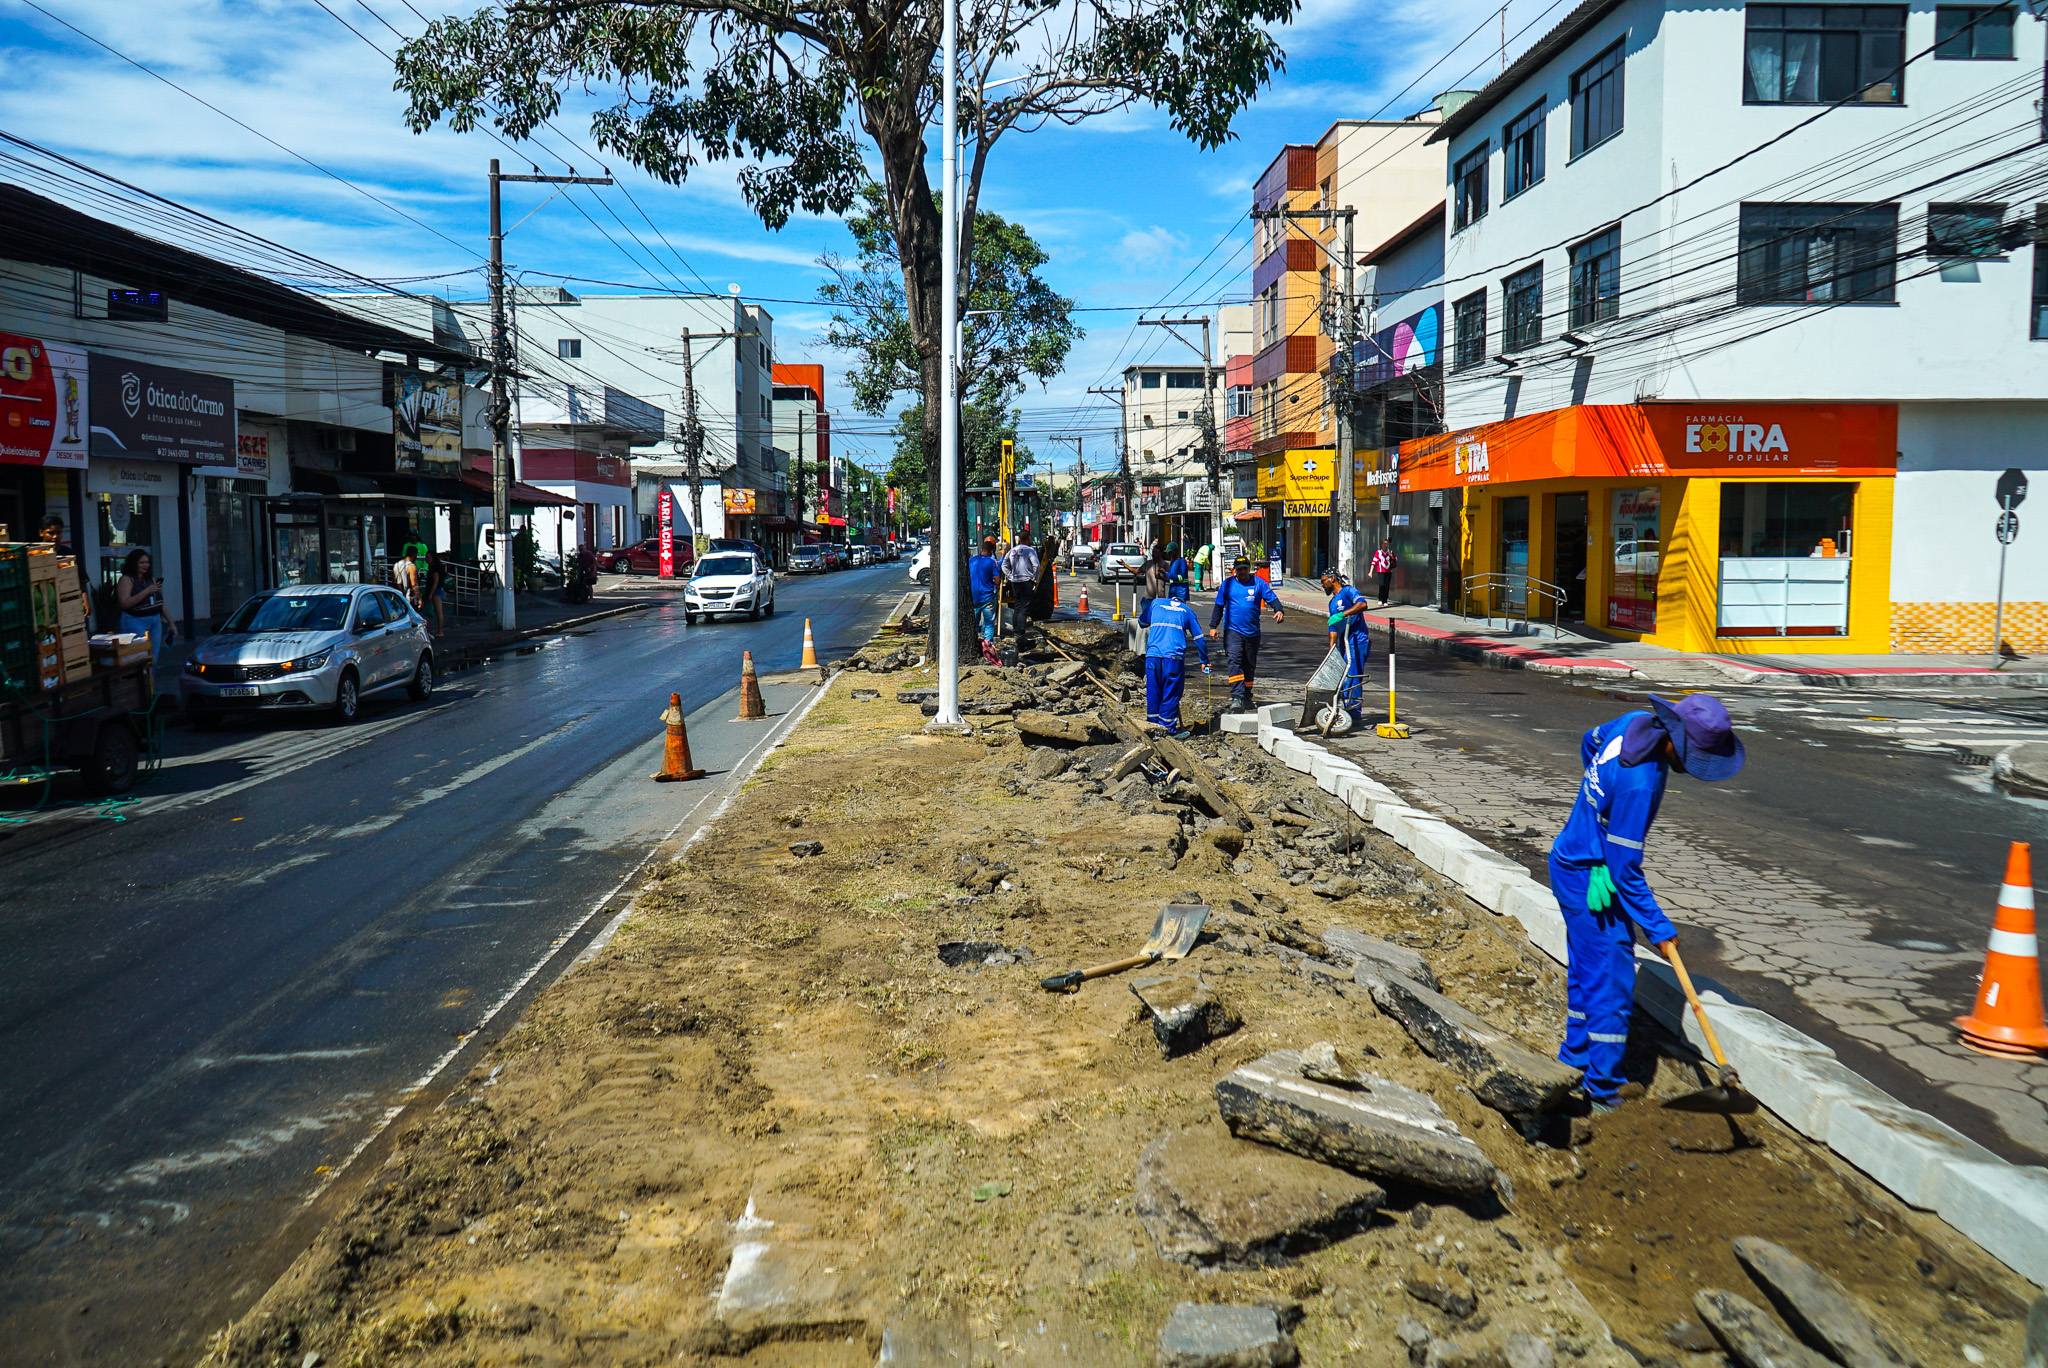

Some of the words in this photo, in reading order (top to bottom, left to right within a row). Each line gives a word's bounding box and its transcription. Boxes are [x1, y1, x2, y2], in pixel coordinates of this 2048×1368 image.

[0, 347, 32, 381] O
[147, 381, 178, 410] Ótica
[178, 390, 191, 411] do
[191, 394, 224, 416] Carmo
[31, 417, 51, 427] Lenovo
[168, 416, 174, 425] DA
[174, 417, 184, 426] SUA
[1686, 413, 1744, 424] FARMÁCIA
[1686, 424, 1789, 453] EXTRA
[56, 451, 73, 460] DESDE
[74, 453, 84, 461] 1999
[1728, 454, 1789, 462] POPULAR
[242, 457, 267, 470] CARNES
[121, 467, 136, 480] Ótica
[144, 472, 162, 482] Carmo
[1290, 474, 1309, 482] Super
[1309, 474, 1330, 482] Poupe
[1366, 469, 1398, 488] MedHospice
[1468, 474, 1489, 483] POPULAR
[1288, 501, 1331, 514] FARMÁCIA
